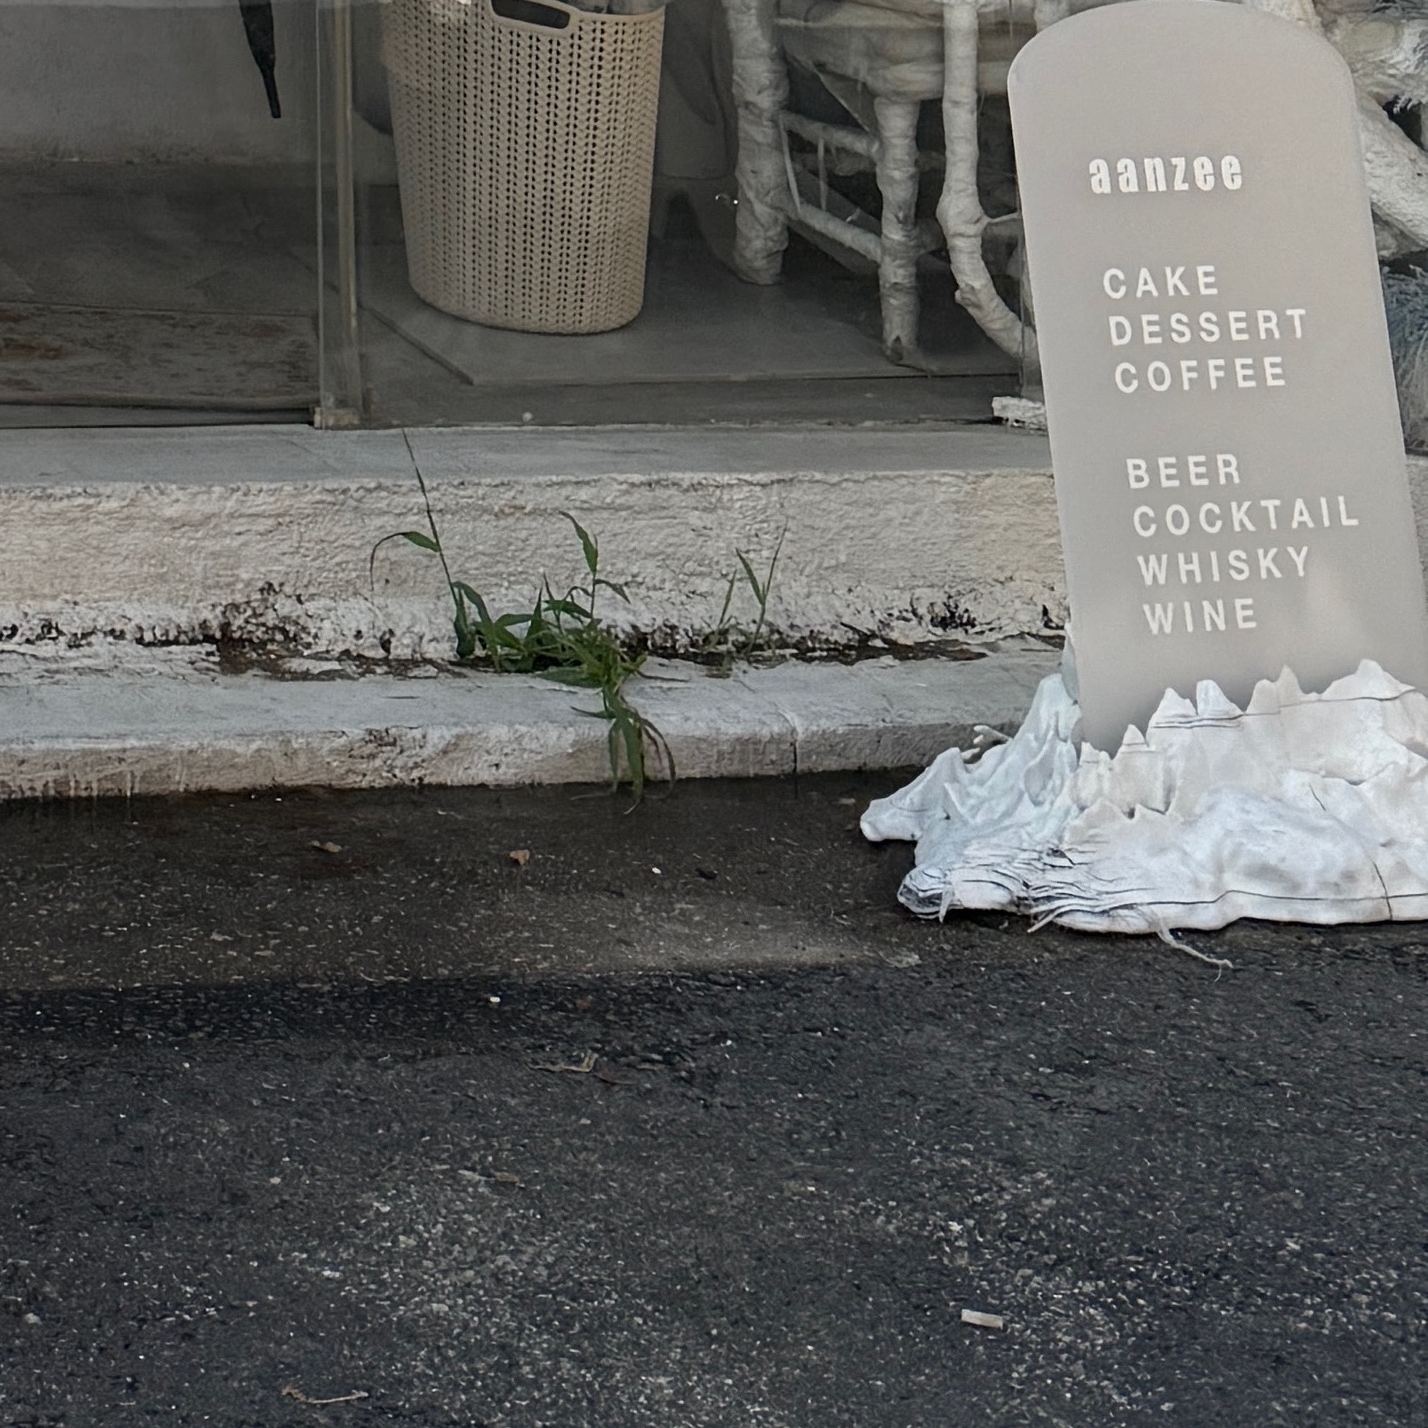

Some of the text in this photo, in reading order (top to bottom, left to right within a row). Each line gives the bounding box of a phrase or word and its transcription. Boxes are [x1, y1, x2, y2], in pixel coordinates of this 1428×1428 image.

[1089, 154, 1243, 194] aanzee
[1102, 265, 1219, 300] CAKE
[1108, 308, 1307, 346] DESSERT
[1114, 356, 1286, 394] COFFEE
[1126, 453, 1241, 490] BEER
[1133, 496, 1359, 537] COCKTAIL
[1137, 545, 1309, 586] WHISKY
[1143, 598, 1257, 636] WINE
